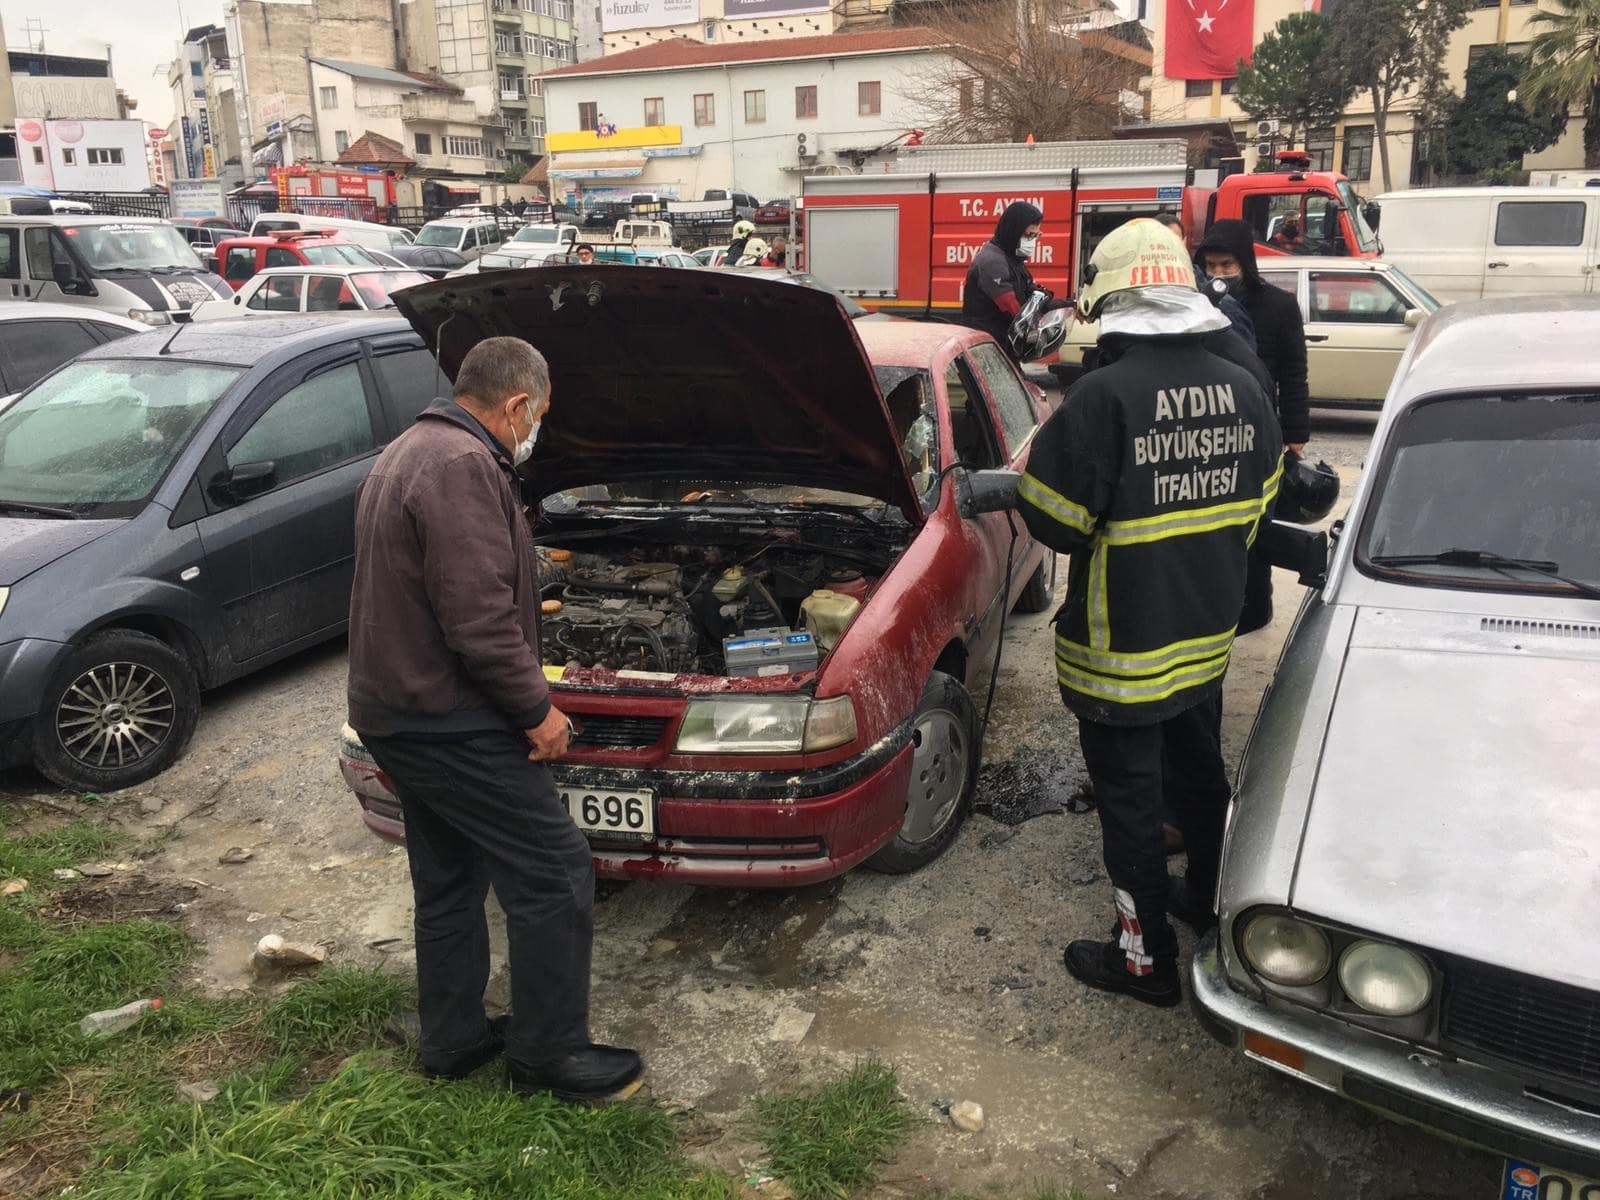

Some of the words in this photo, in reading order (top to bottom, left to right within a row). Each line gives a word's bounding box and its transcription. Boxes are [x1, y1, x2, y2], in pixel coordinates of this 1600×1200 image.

[959, 198, 988, 217] T.C.
[1154, 384, 1236, 422] AYDIN
[1134, 418, 1255, 465] BÜYÜKŞEHİR
[1154, 460, 1239, 506] İTFAİYESİ
[582, 794, 645, 829] 696
[1511, 1186, 1534, 1200] TR
